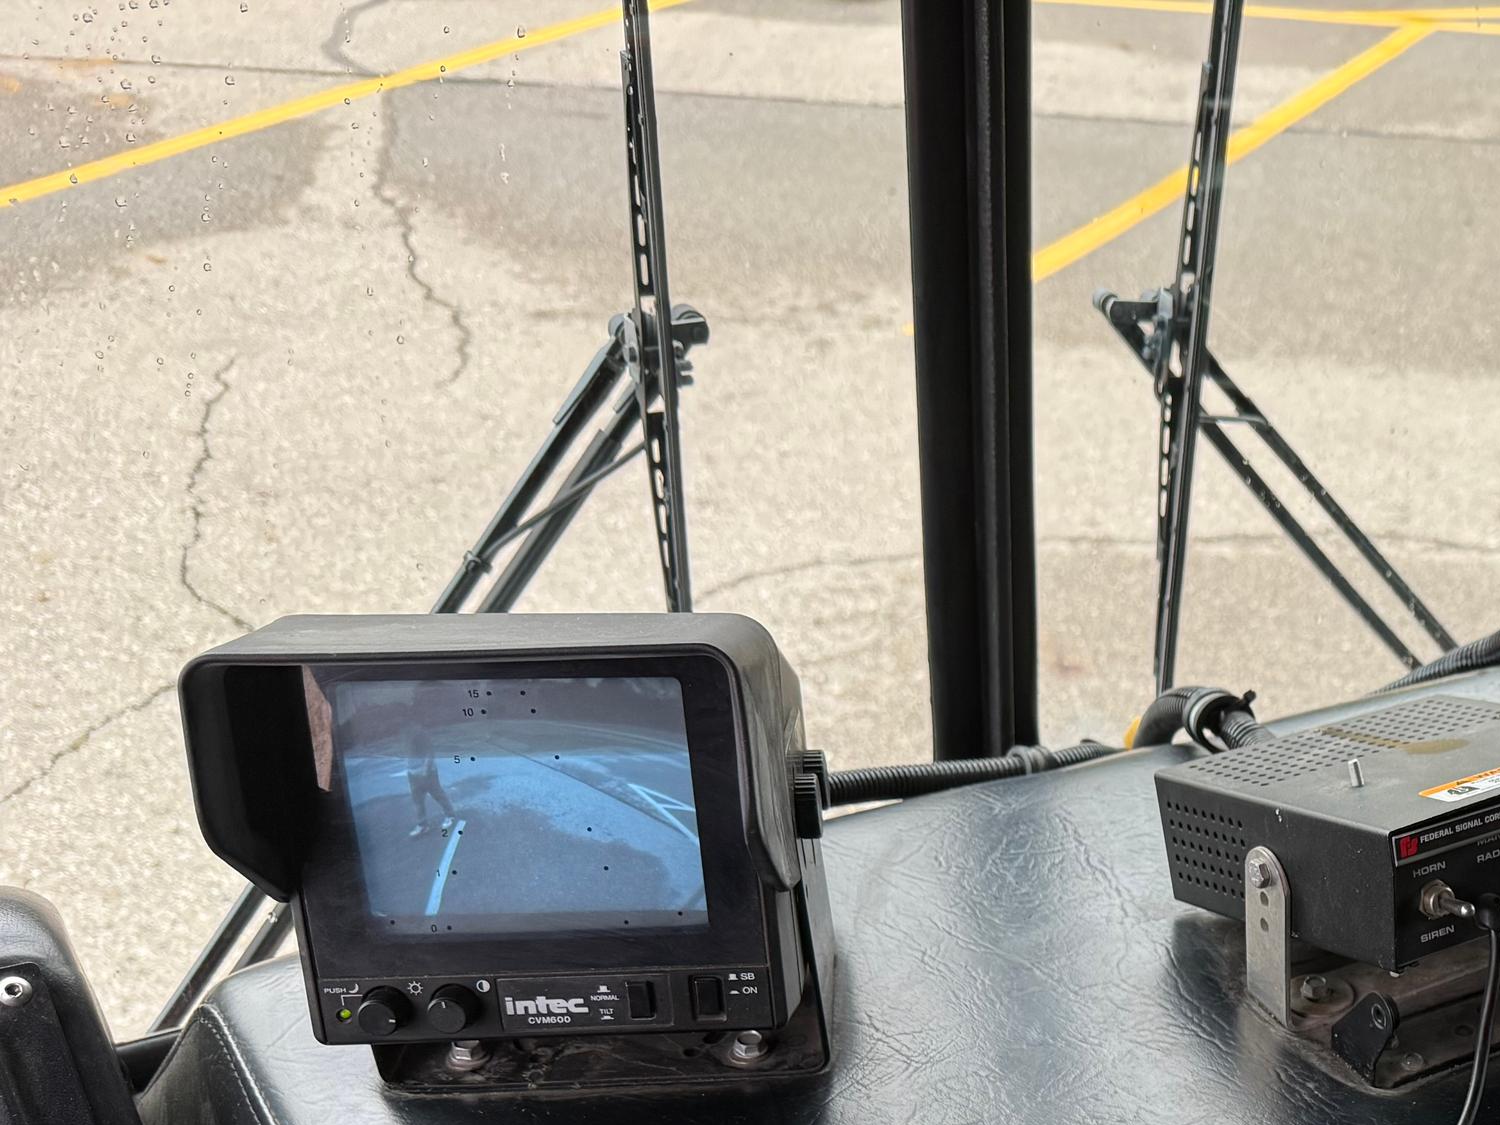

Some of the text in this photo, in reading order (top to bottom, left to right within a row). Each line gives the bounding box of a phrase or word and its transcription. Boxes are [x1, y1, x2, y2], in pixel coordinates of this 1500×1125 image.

[467, 689, 479, 699] 15
[462, 707, 474, 717] 10
[454, 755, 461, 764] 5
[441, 829, 449, 838] 2
[1419, 827, 1454, 844] FEDERAL
[1455, 816, 1483, 833] SIGNAL
[1412, 860, 1446, 878] HORN
[430, 924, 438, 933] 0
[1420, 924, 1455, 943] SIREN
[740, 972, 756, 981] SB
[742, 986, 758, 994] ON
[590, 994, 620, 1002] NORMAL
[504, 995, 590, 1016] intec
[527, 1016, 571, 1025] CVM600
